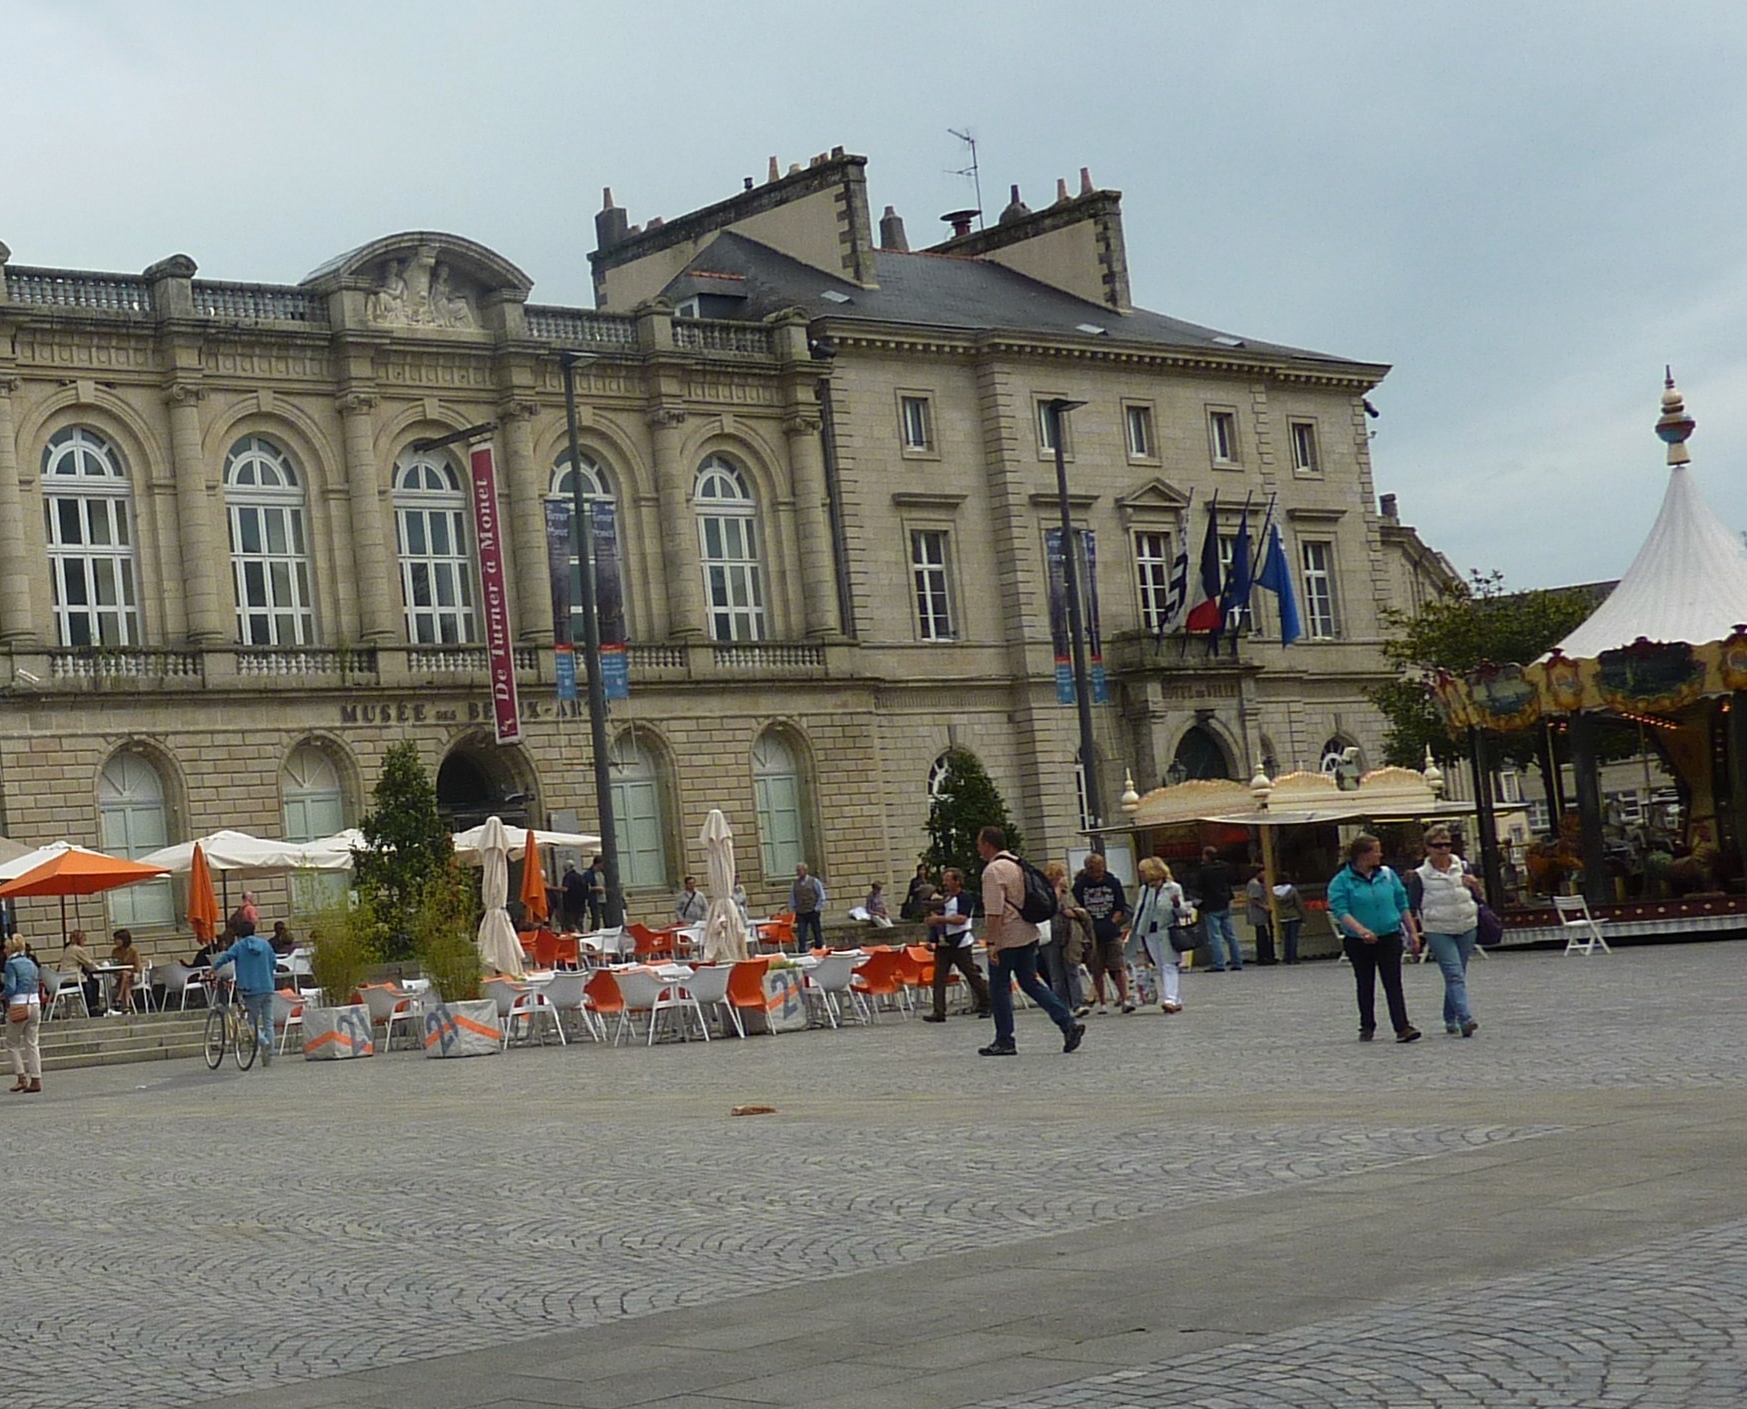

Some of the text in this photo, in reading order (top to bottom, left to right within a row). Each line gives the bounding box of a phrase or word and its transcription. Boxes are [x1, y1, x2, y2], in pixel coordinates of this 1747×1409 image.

[476, 478, 509, 701] De Turner à Monet
[341, 701, 427, 723] MUSÉE
